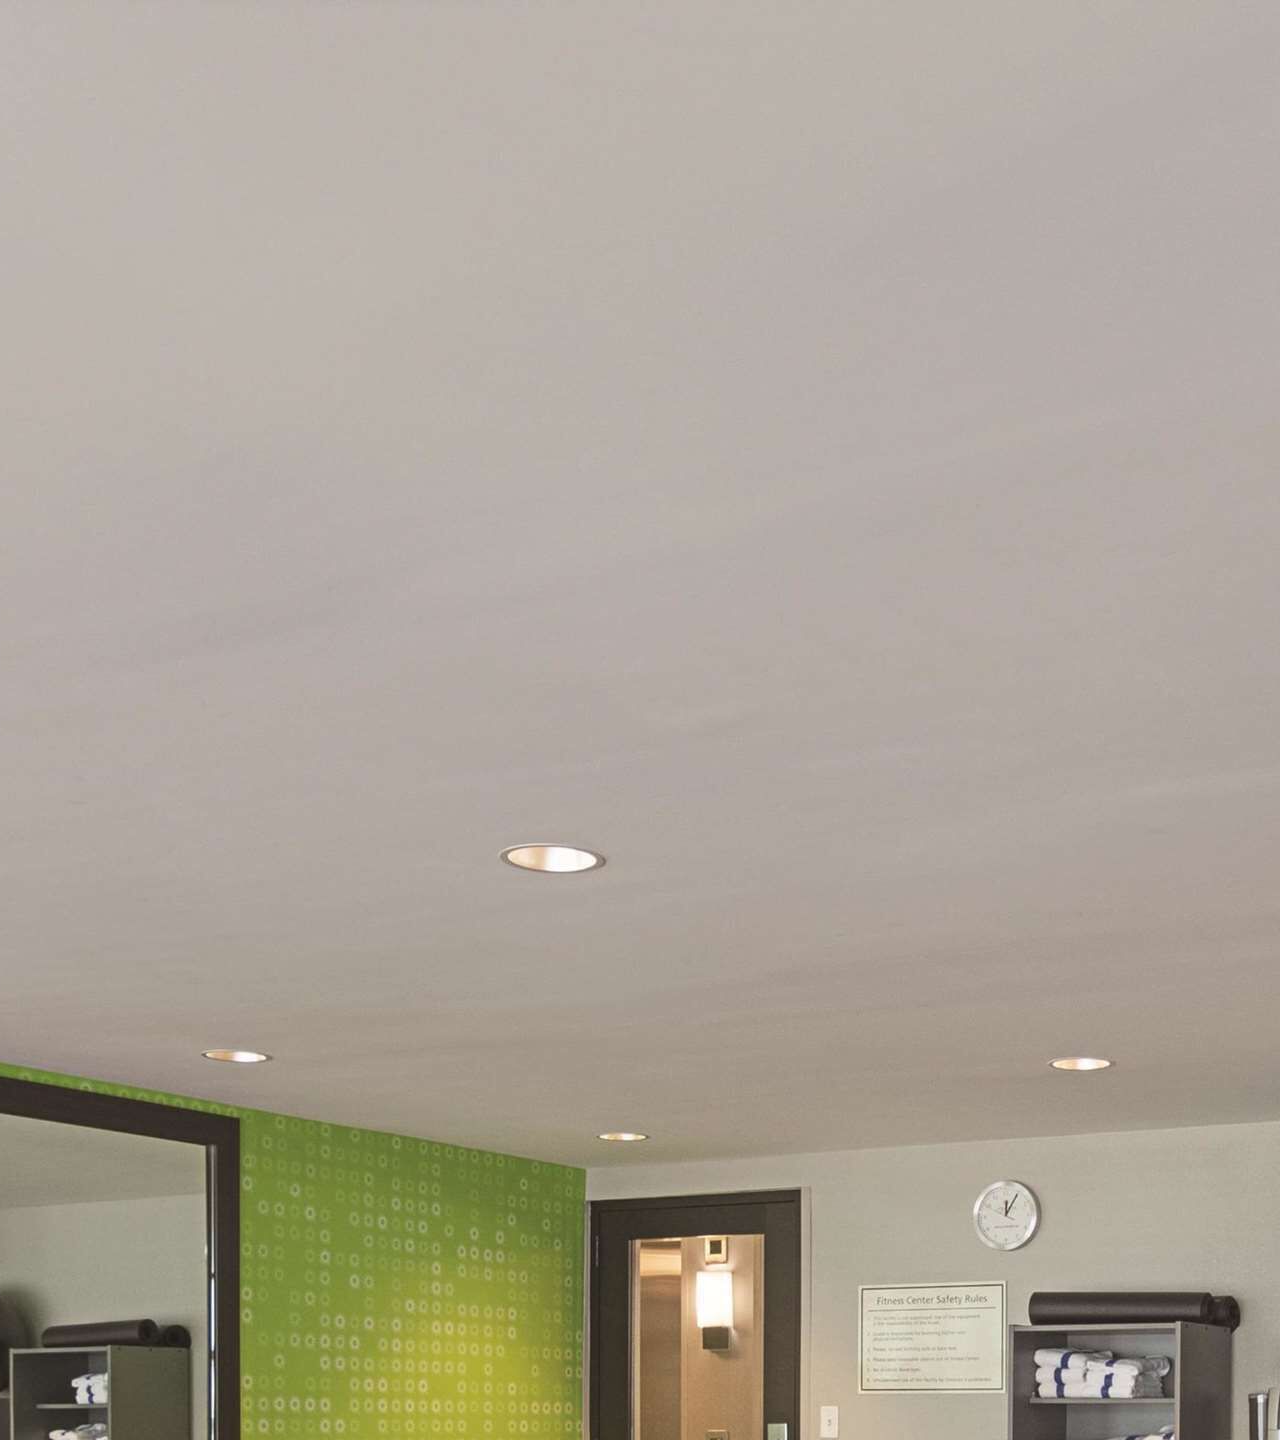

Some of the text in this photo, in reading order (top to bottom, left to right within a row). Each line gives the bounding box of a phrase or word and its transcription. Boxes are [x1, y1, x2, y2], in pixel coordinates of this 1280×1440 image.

[876, 1294, 988, 1305] Fitness Center Safety Rules
